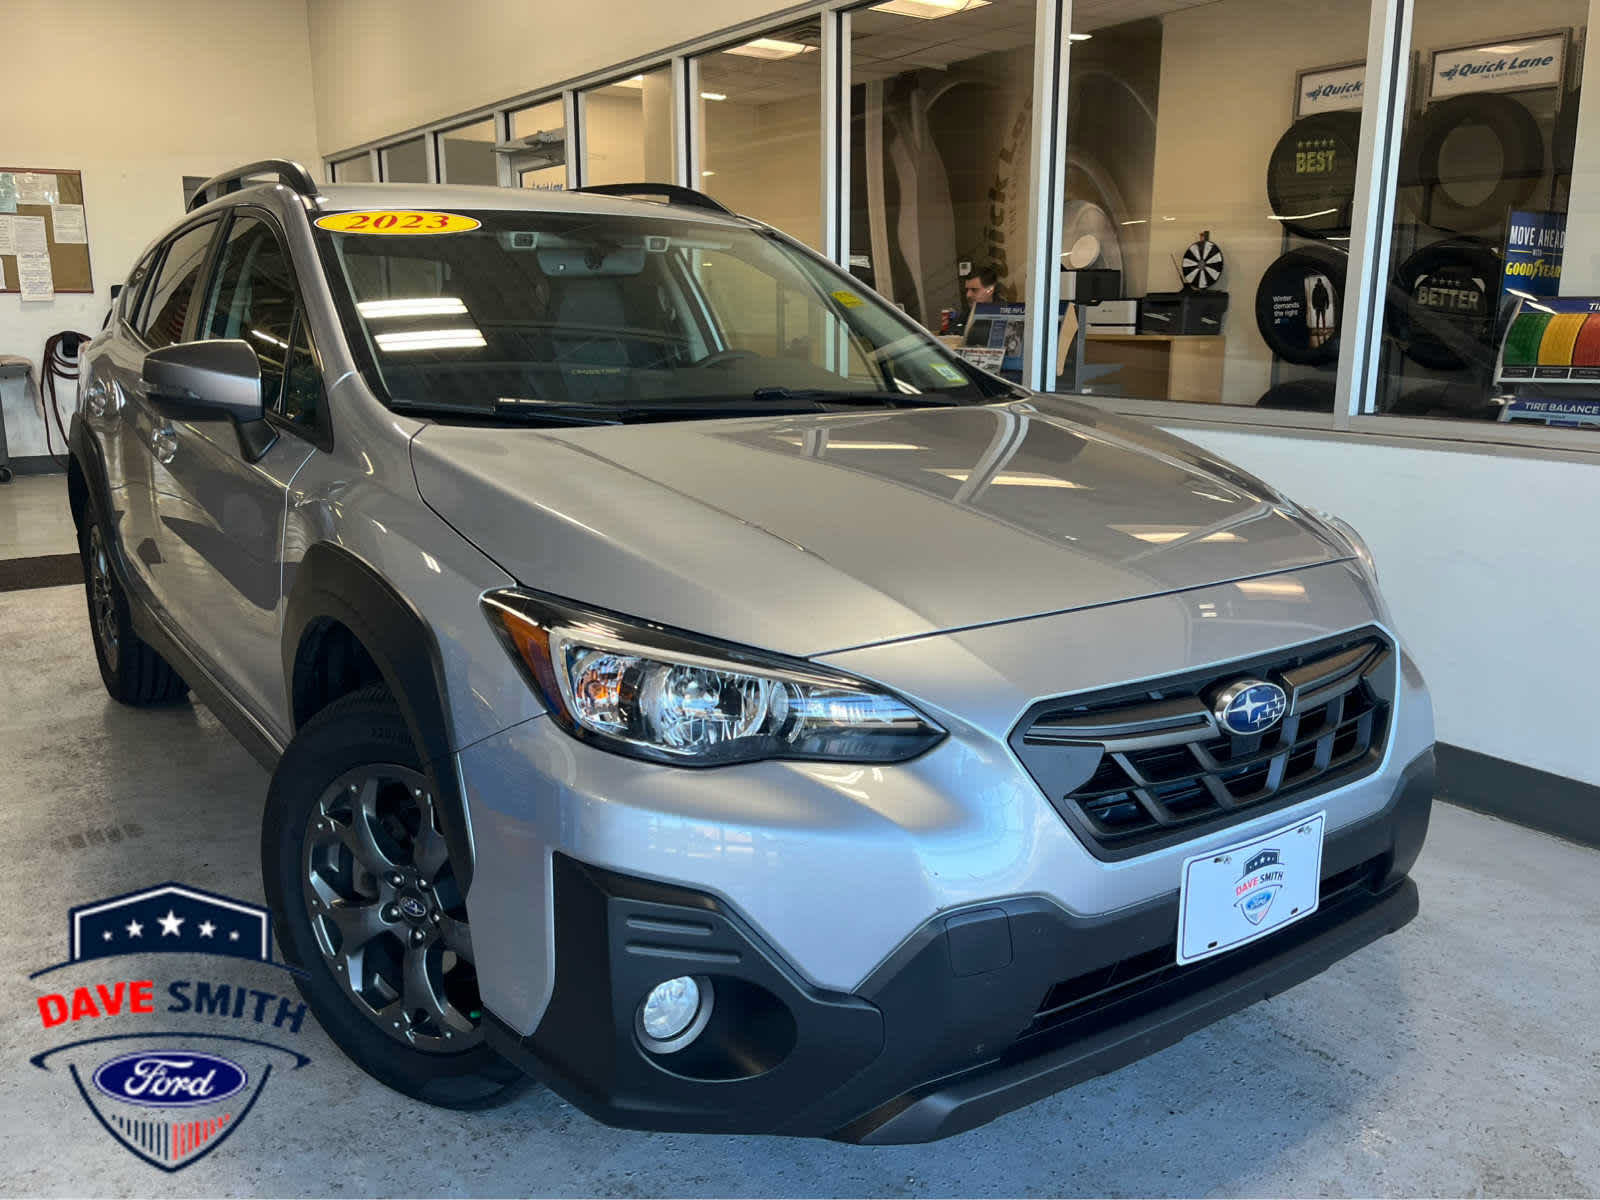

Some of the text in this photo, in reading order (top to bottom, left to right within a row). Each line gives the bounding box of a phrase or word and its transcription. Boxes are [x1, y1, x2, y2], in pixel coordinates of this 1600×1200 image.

[1459, 60, 1504, 77] Quick
[1507, 55, 1553, 70] Lane
[1322, 82, 1362, 97] Quick
[1296, 150, 1336, 174] BEST
[346, 214, 450, 230] 2023
[1509, 225, 1566, 249] MOVE AHEAD
[1272, 295, 1292, 303] Winter
[1273, 302, 1300, 310] demands
[1416, 287, 1480, 311] BETTER
[1284, 310, 1299, 318] right
[1525, 401, 1599, 415] TIRE BALANCE
[1236, 871, 1284, 896] DAVE SMITH
